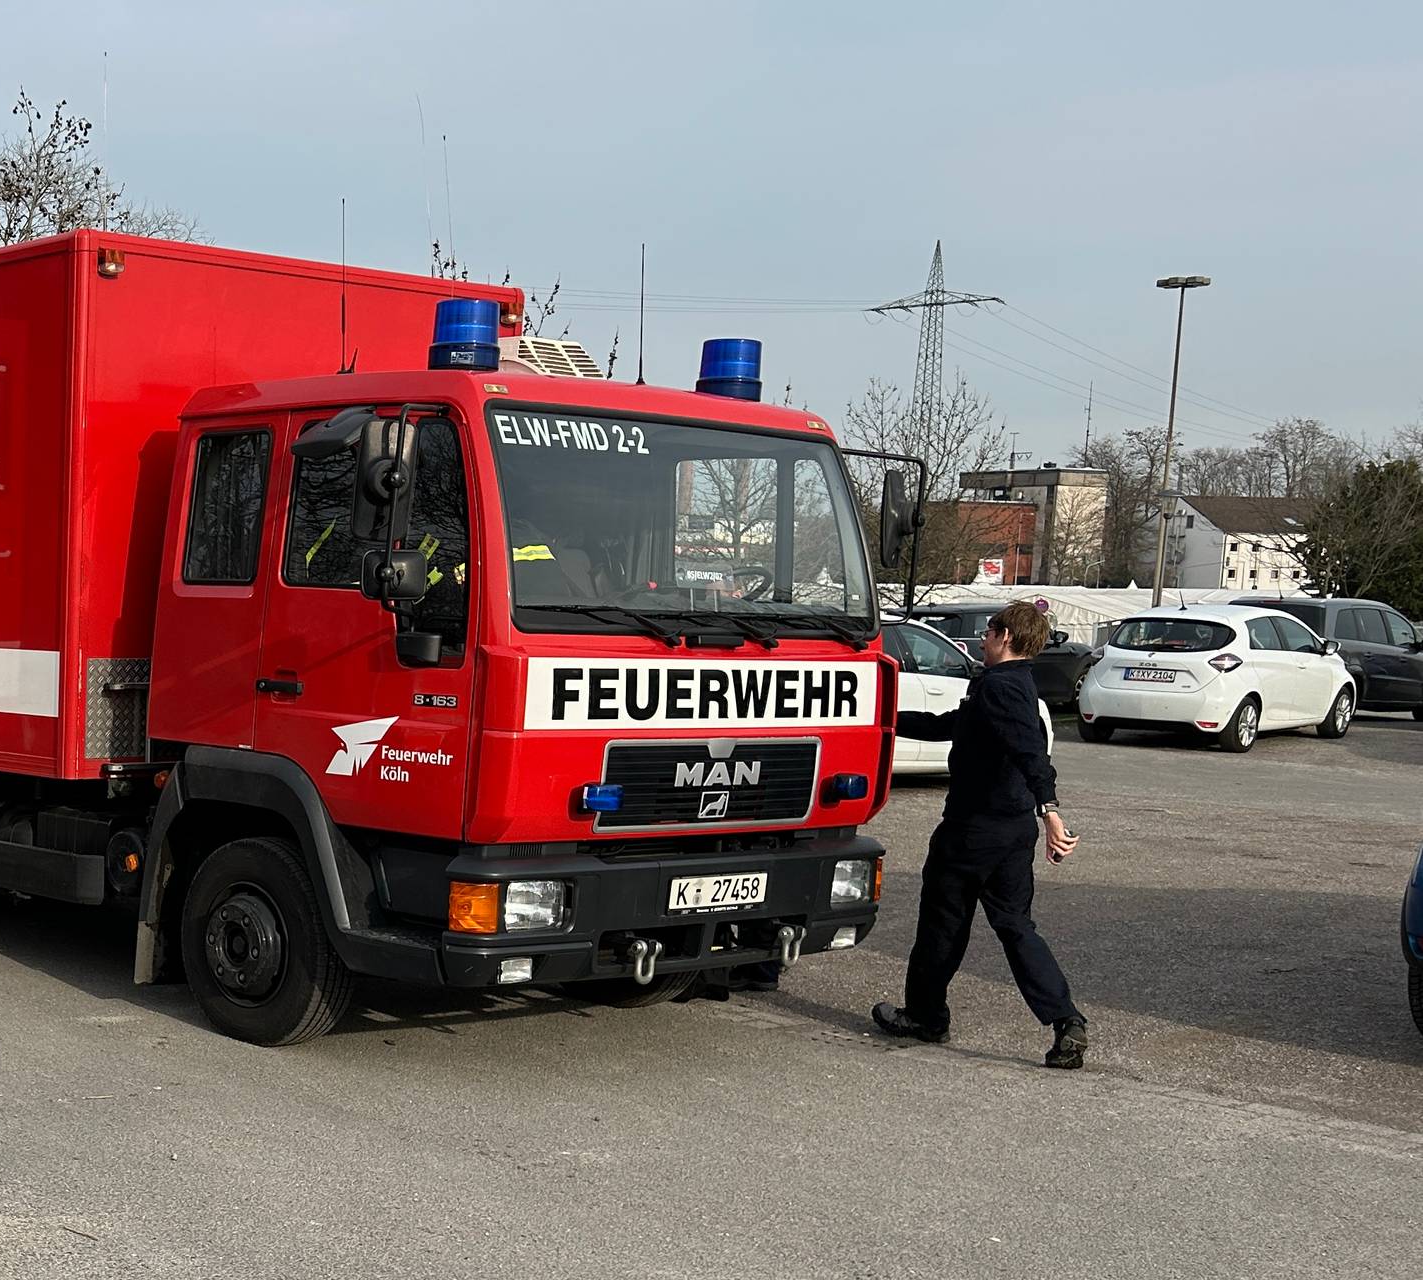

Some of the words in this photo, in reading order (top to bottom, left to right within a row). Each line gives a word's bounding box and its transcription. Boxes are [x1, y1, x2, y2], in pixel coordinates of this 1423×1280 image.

[494, 414, 609, 451] ELW-FMD
[611, 425, 650, 455] 2-2
[1152, 671, 1174, 680] 2104
[551, 668, 858, 721] FEUERWEHR
[381, 745, 454, 766] Feuerwehr
[380, 765, 410, 782] Köln
[674, 761, 761, 787] MAN
[676, 882, 690, 905] K
[711, 877, 760, 902] 27458
